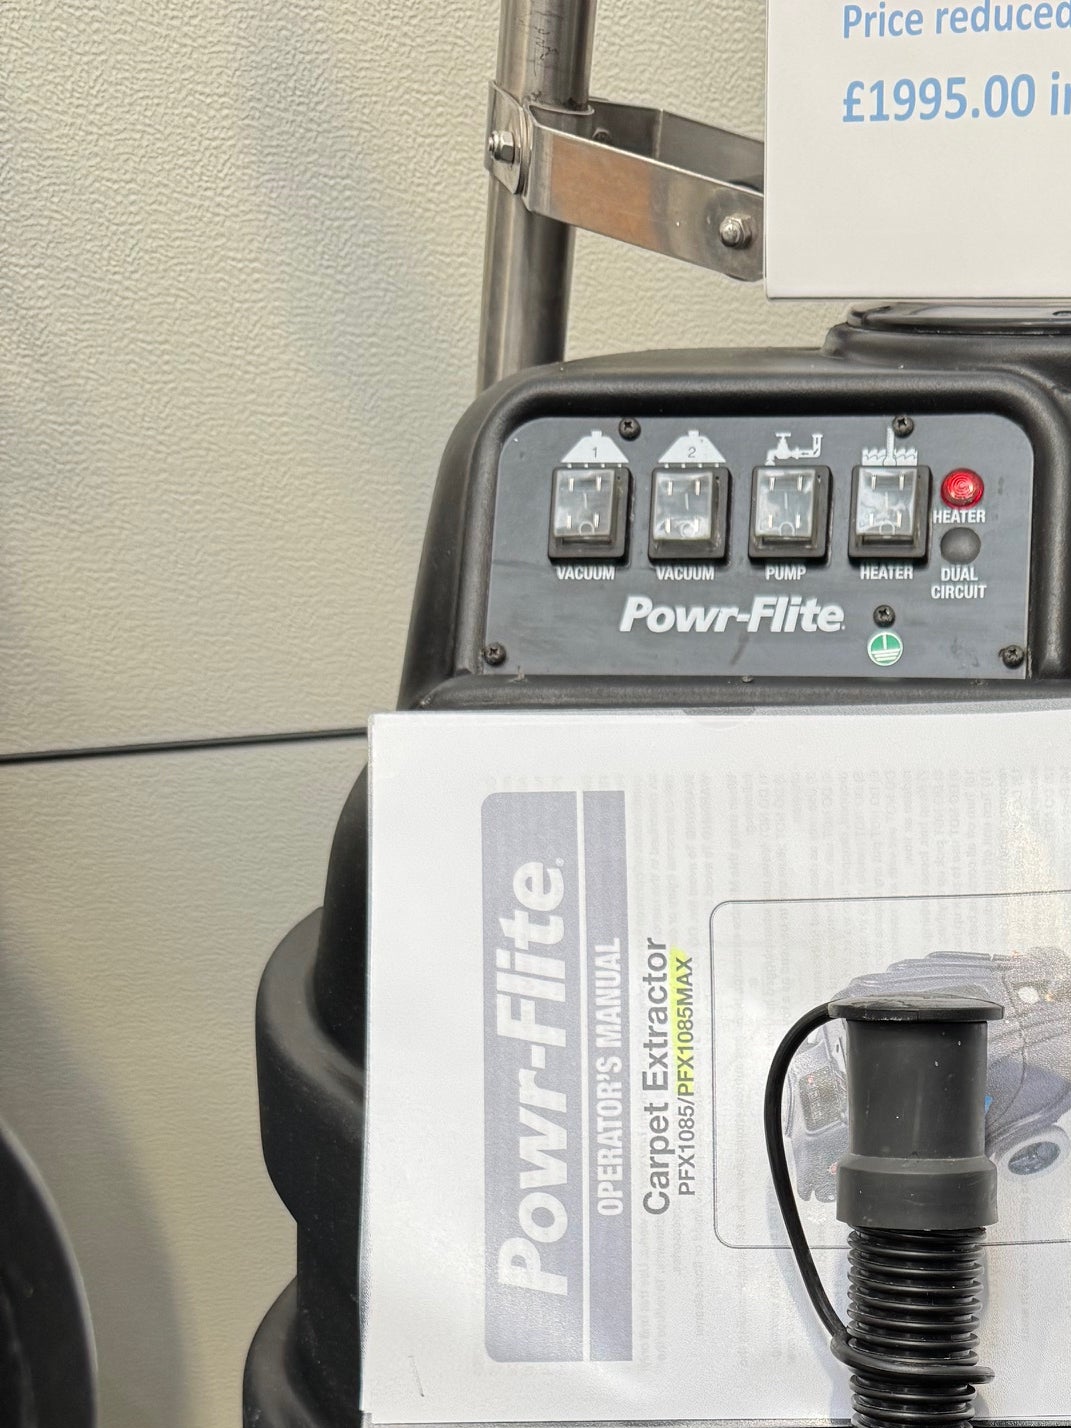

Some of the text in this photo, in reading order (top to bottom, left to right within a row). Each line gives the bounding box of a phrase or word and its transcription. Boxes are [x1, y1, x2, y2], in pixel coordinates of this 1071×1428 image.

[843, 2, 924, 39] Price
[842, 73, 1036, 123] £1995.00
[932, 510, 986, 523] HEATER
[556, 566, 615, 580] VACUUM
[656, 566, 715, 580] VACUUM
[765, 565, 807, 580] PUMP
[860, 565, 914, 580] HEATER
[940, 567, 978, 581] DUAL
[931, 585, 987, 599] CIRCUIT
[619, 595, 845, 633] Powr-Flite
[642, 938, 670, 1090] Extractor
[594, 937, 624, 1215] OPERATOR'S MANUAL
[675, 956, 697, 1196] PFX1085/PFX1085MAX
[644, 1098, 674, 1215] Carpet
